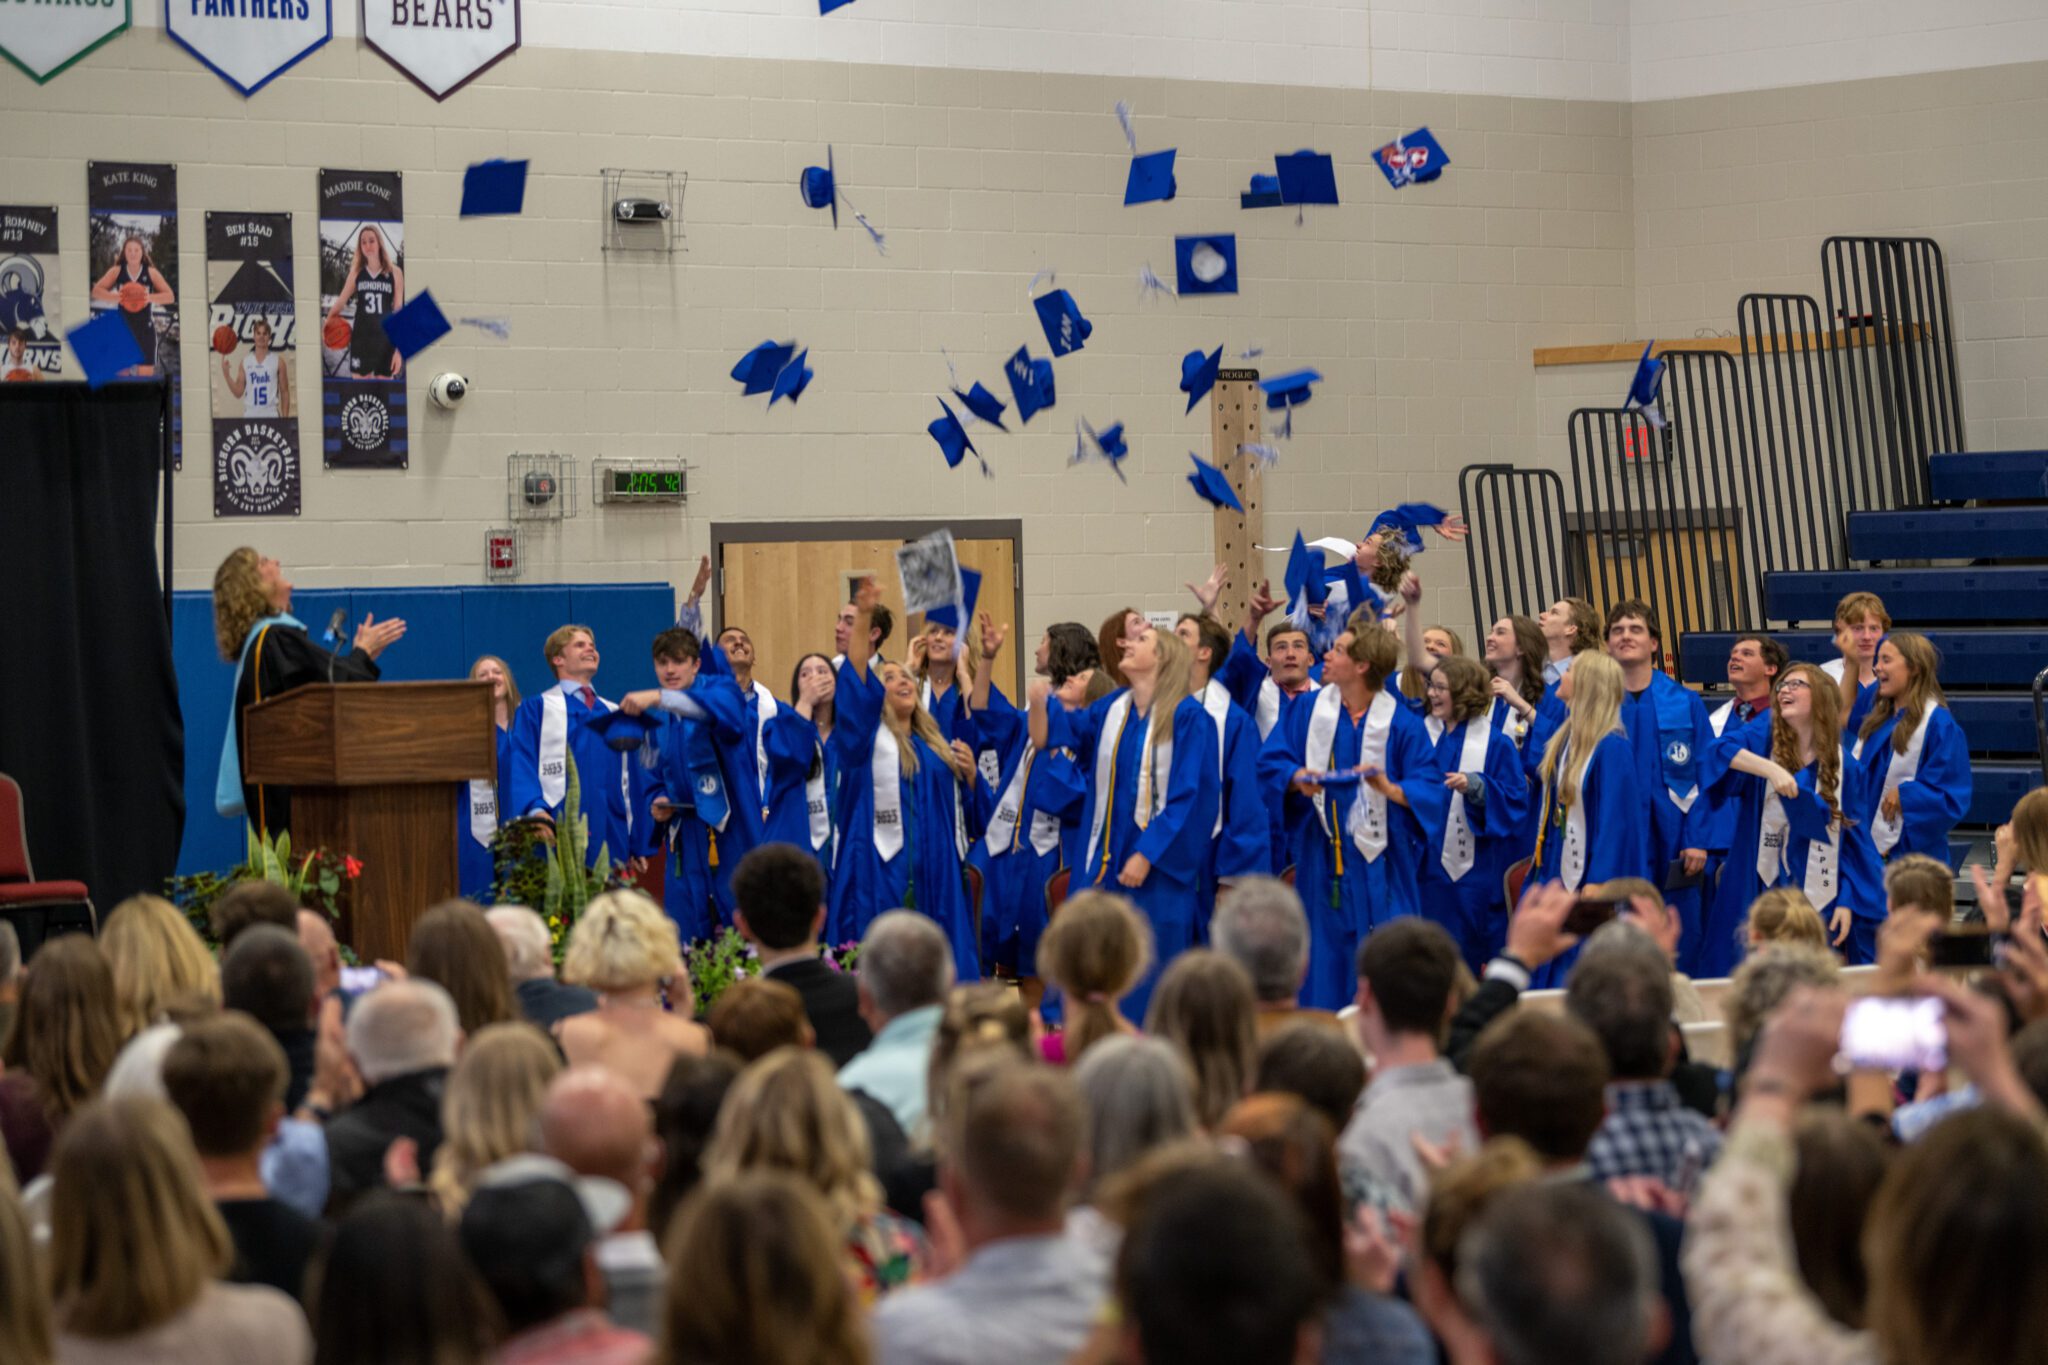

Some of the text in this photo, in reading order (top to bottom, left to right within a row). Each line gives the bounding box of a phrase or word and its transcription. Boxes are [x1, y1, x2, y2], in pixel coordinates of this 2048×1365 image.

[392, 0, 493, 30] BEARS
[103, 171, 158, 189] KATE KING
[324, 180, 392, 201] MADDIE CONE
[4, 214, 48, 237] ROMNEY
[225, 222, 273, 238] BEN SAAD
[364, 292, 383, 315] 31
[1222, 370, 1253, 380] ROGUE
[253, 386, 268, 407] 15
[218, 423, 296, 482] BIGHORN BASKETBALL
